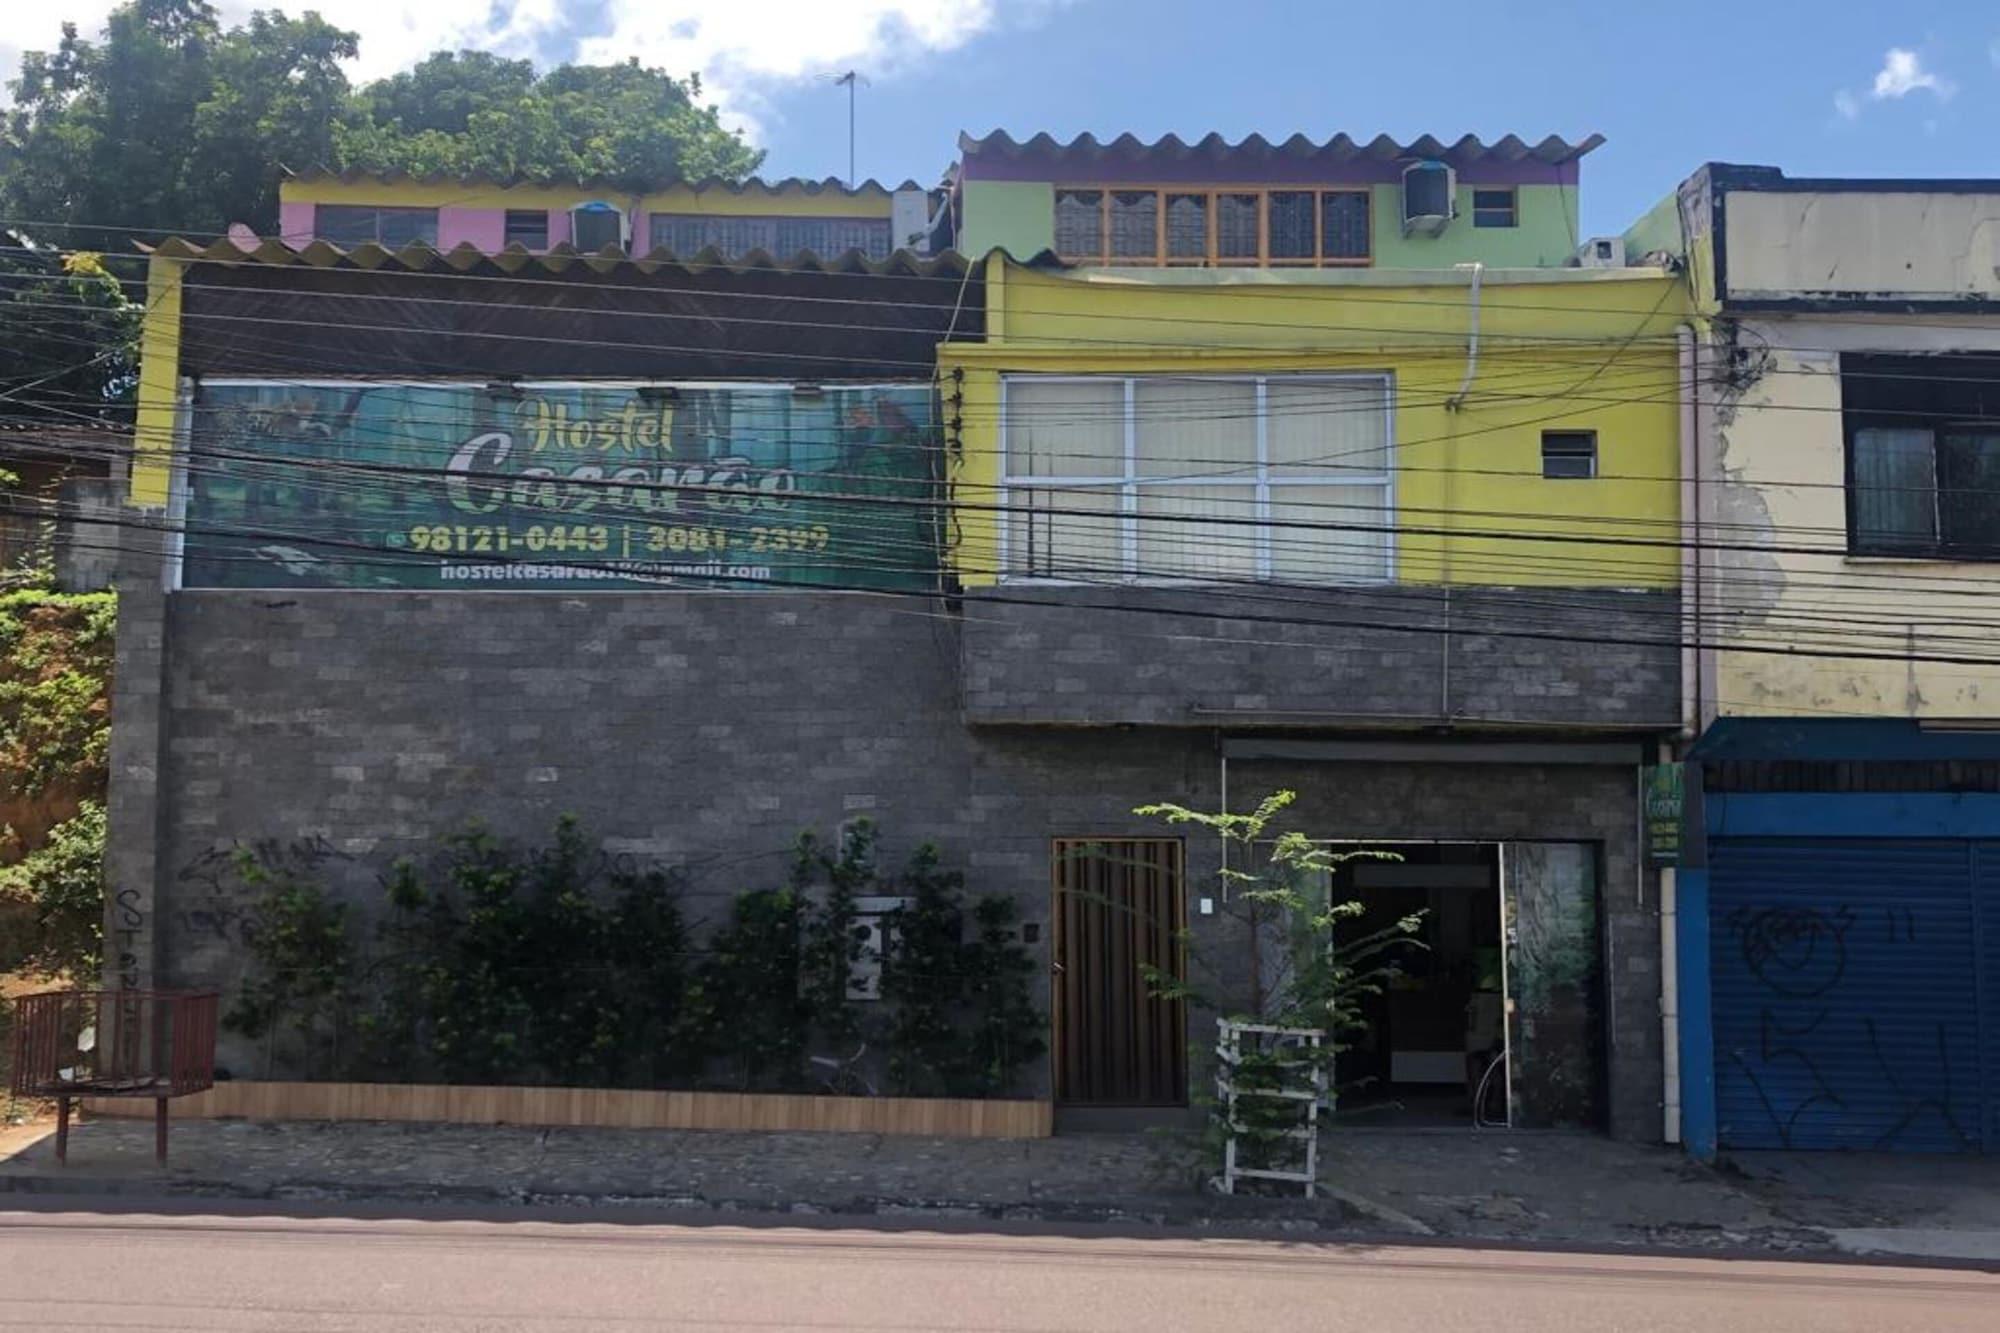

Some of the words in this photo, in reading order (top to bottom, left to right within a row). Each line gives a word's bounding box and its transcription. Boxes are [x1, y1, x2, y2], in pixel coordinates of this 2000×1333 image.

[515, 396, 673, 452] Hostel
[446, 432, 795, 515] Casarão
[409, 524, 609, 552] 98121-0443
